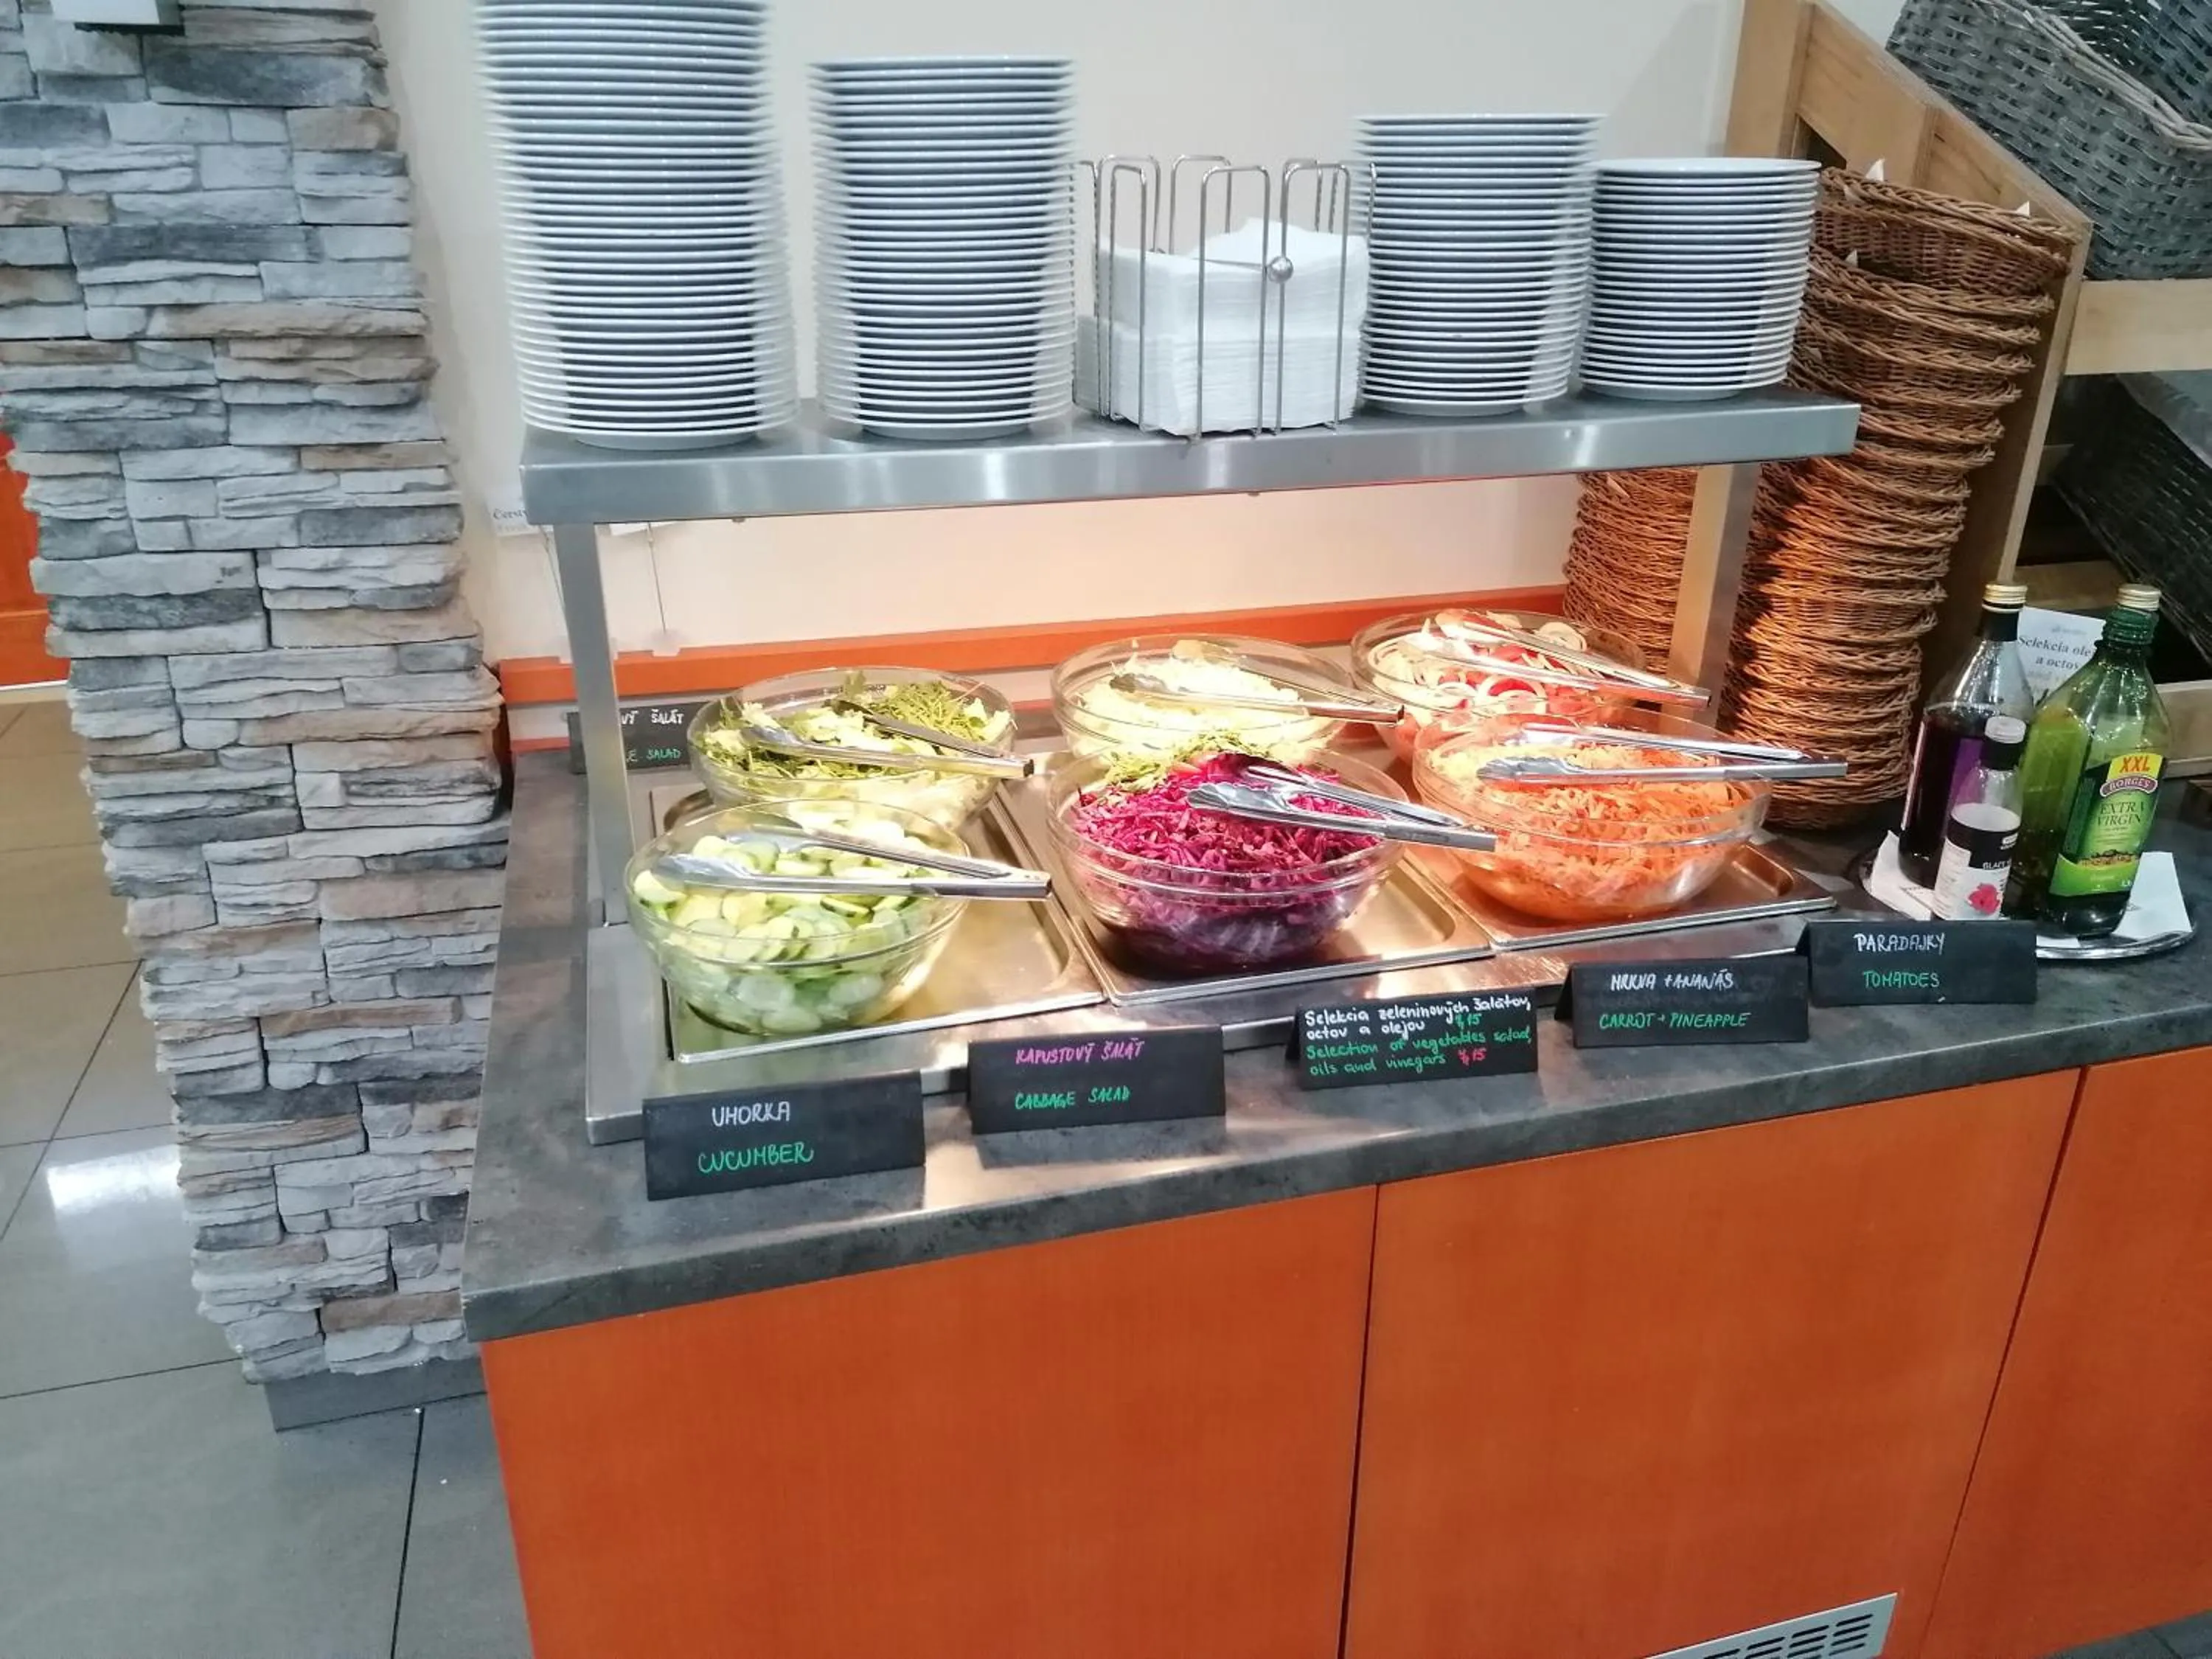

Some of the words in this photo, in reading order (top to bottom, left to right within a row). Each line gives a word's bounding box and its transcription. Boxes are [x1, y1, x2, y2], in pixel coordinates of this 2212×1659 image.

[2018, 637, 2069, 654] Selekcia
[2072, 646, 2092, 657] ole
[646, 748, 681, 761] SALAD
[2119, 755, 2150, 773] XXL
[2109, 777, 2151, 790] BORGES
[2099, 801, 2145, 815] EXTRA
[2096, 813, 2141, 826] VIRGIN
[1853, 932, 1945, 955] PARADAJKY
[1863, 970, 1941, 989] TOMATOES
[1304, 1006, 1369, 1027] Selekcia
[1599, 1012, 1657, 1030] CARROT
[1669, 1012, 1752, 1029] PINEAPPLE
[1306, 1026, 1347, 1040] octov
[1360, 1025, 1371, 1035] a
[1015, 1043, 1096, 1065] KAPUSTOVÝ
[1306, 1040, 1378, 1060] Selection
[1390, 1037, 1405, 1051] of
[1412, 1032, 1486, 1054] vegetables
[1310, 1060, 1338, 1077] oils
[1344, 1057, 1377, 1074] and
[1385, 1051, 1447, 1074] vinegars
[1015, 1091, 1077, 1110] CABBAGE
[1088, 1085, 1131, 1102] SALAD
[712, 1101, 790, 1127] UHORKA
[698, 1141, 815, 1174] CUCUMBER
